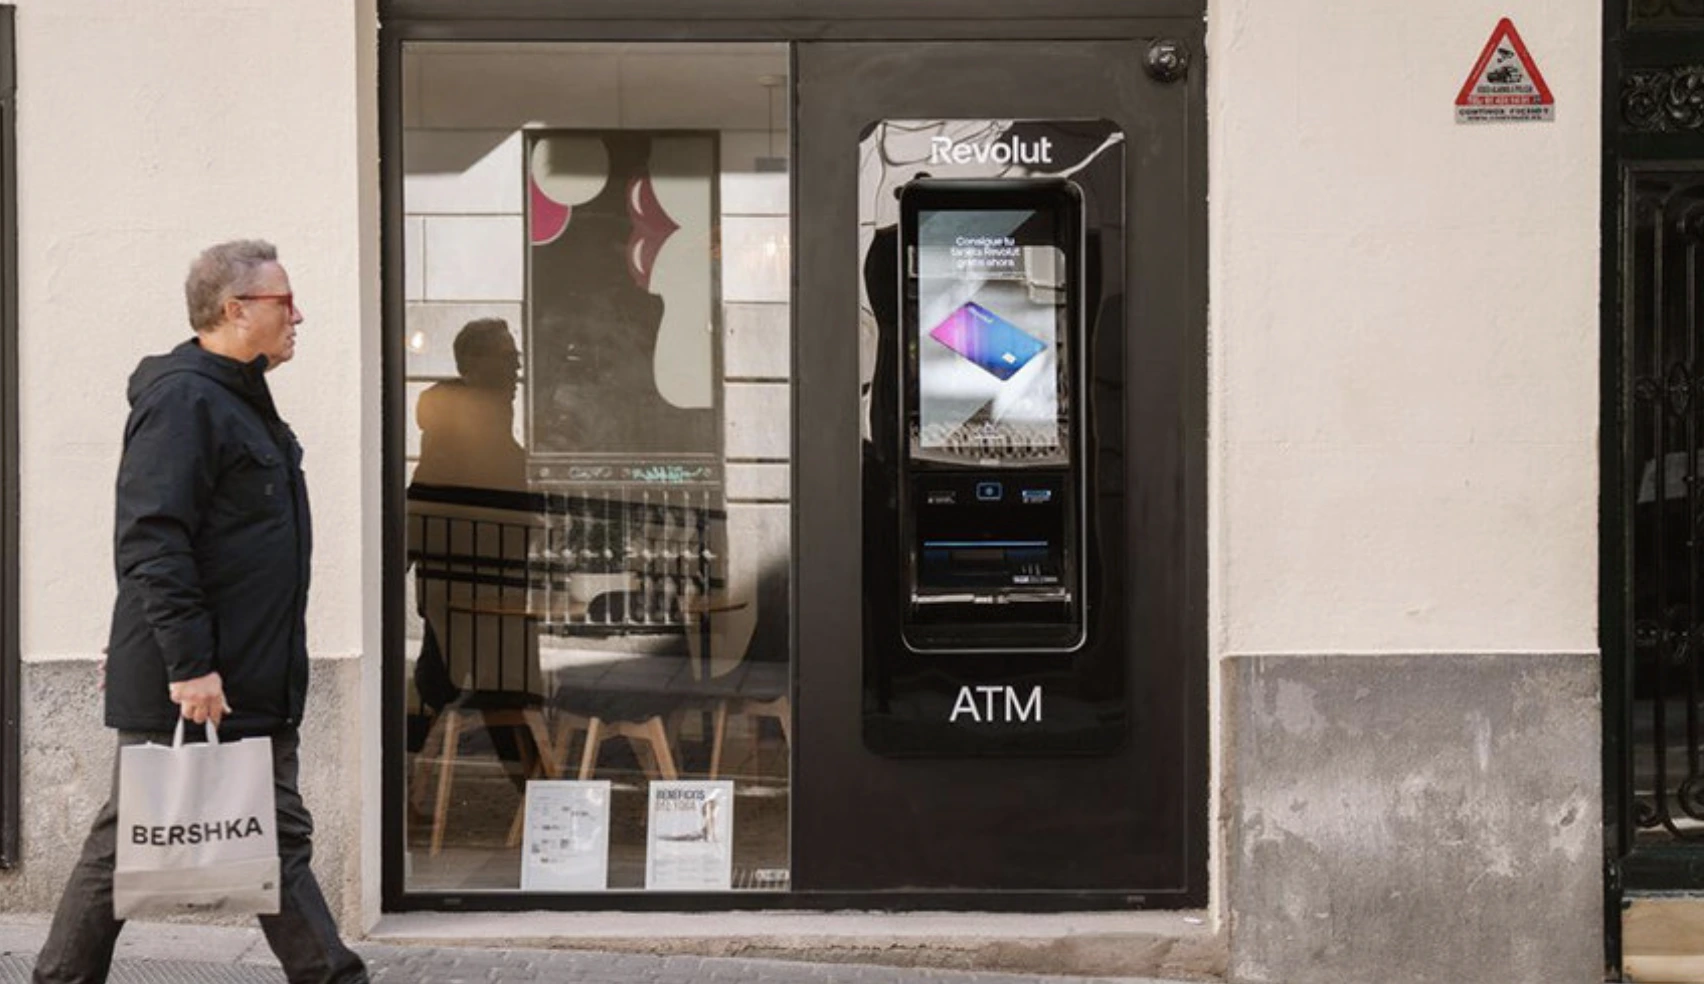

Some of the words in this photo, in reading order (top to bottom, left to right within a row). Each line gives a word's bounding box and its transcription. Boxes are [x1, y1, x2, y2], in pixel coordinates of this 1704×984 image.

[931, 135, 1053, 164] Revolut
[984, 245, 1020, 256] Revolut
[1004, 236, 1016, 246] tu
[949, 685, 1042, 722] ATM
[132, 816, 263, 846] BERSHKA
